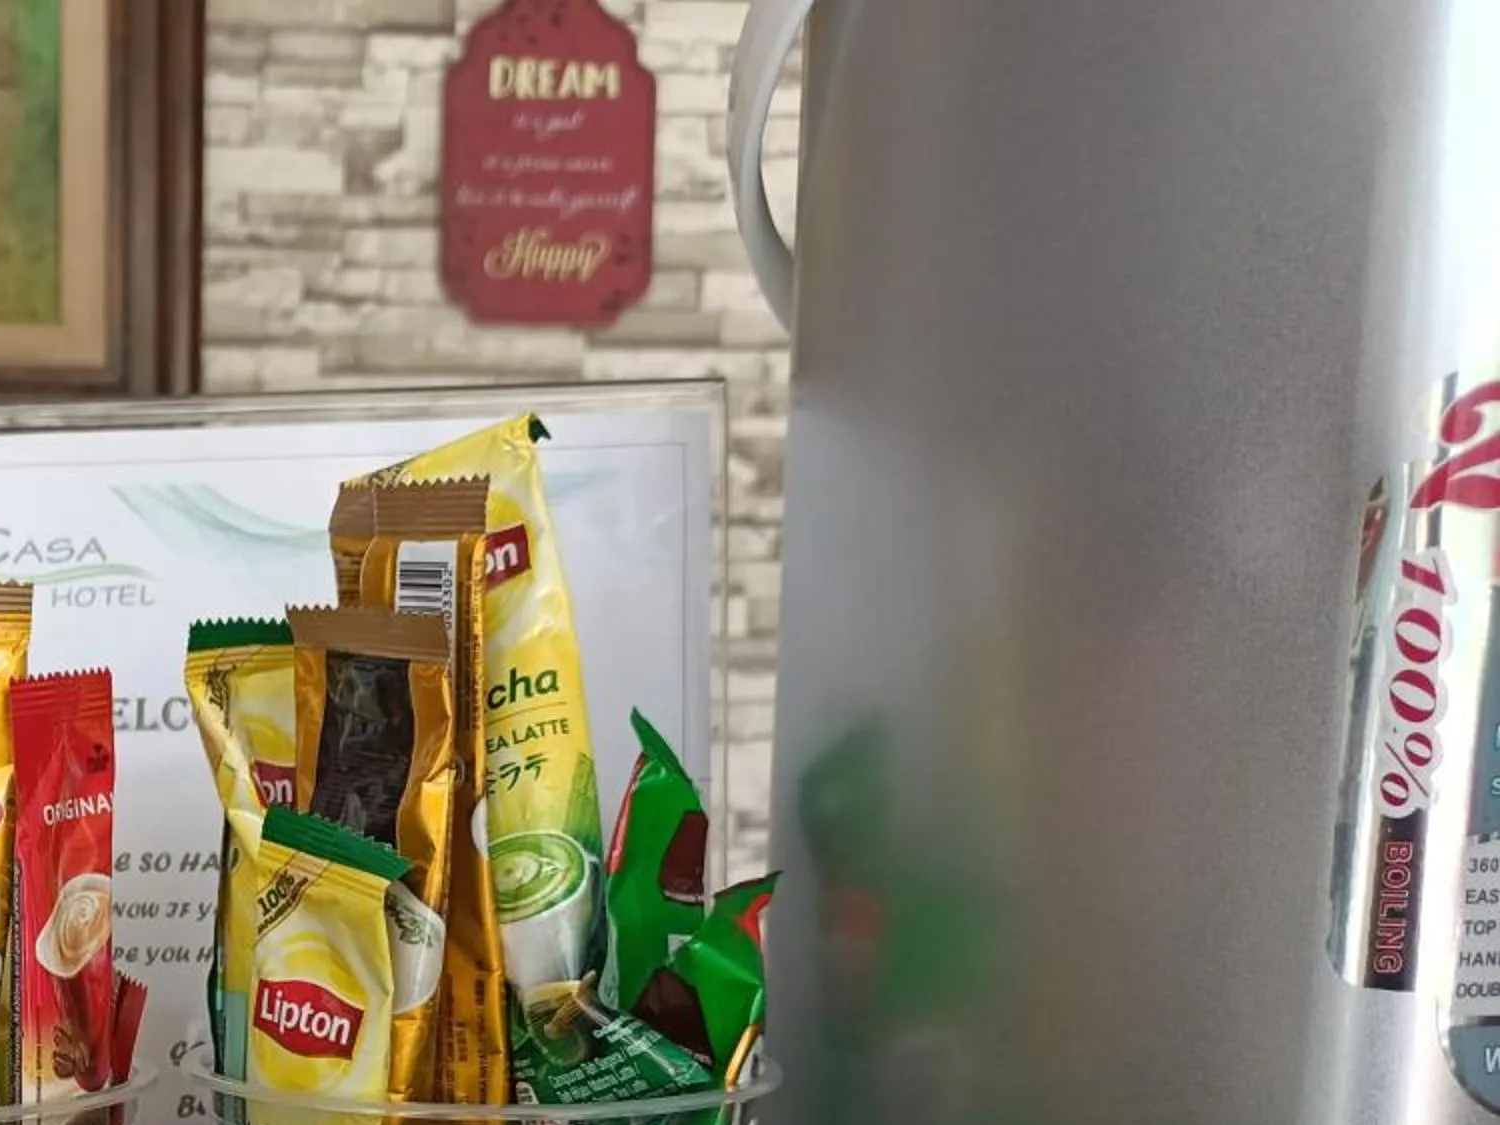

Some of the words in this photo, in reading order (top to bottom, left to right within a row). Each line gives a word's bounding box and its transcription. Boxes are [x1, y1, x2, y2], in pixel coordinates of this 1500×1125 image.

[488, 56, 620, 100] DREAM
[483, 227, 611, 282] Happy
[51, 584, 156, 609] HOTEL
[1380, 552, 1448, 807] 100%
[112, 697, 197, 732] ELC
[511, 719, 570, 745] LATTE
[42, 791, 114, 827] ORGINA
[138, 851, 173, 873] SO
[257, 868, 296, 918] 100%
[1373, 840, 1414, 976] BOILING
[197, 902, 218, 921] Y
[1463, 919, 1497, 937] TOP
[260, 986, 351, 1046] Lipton
